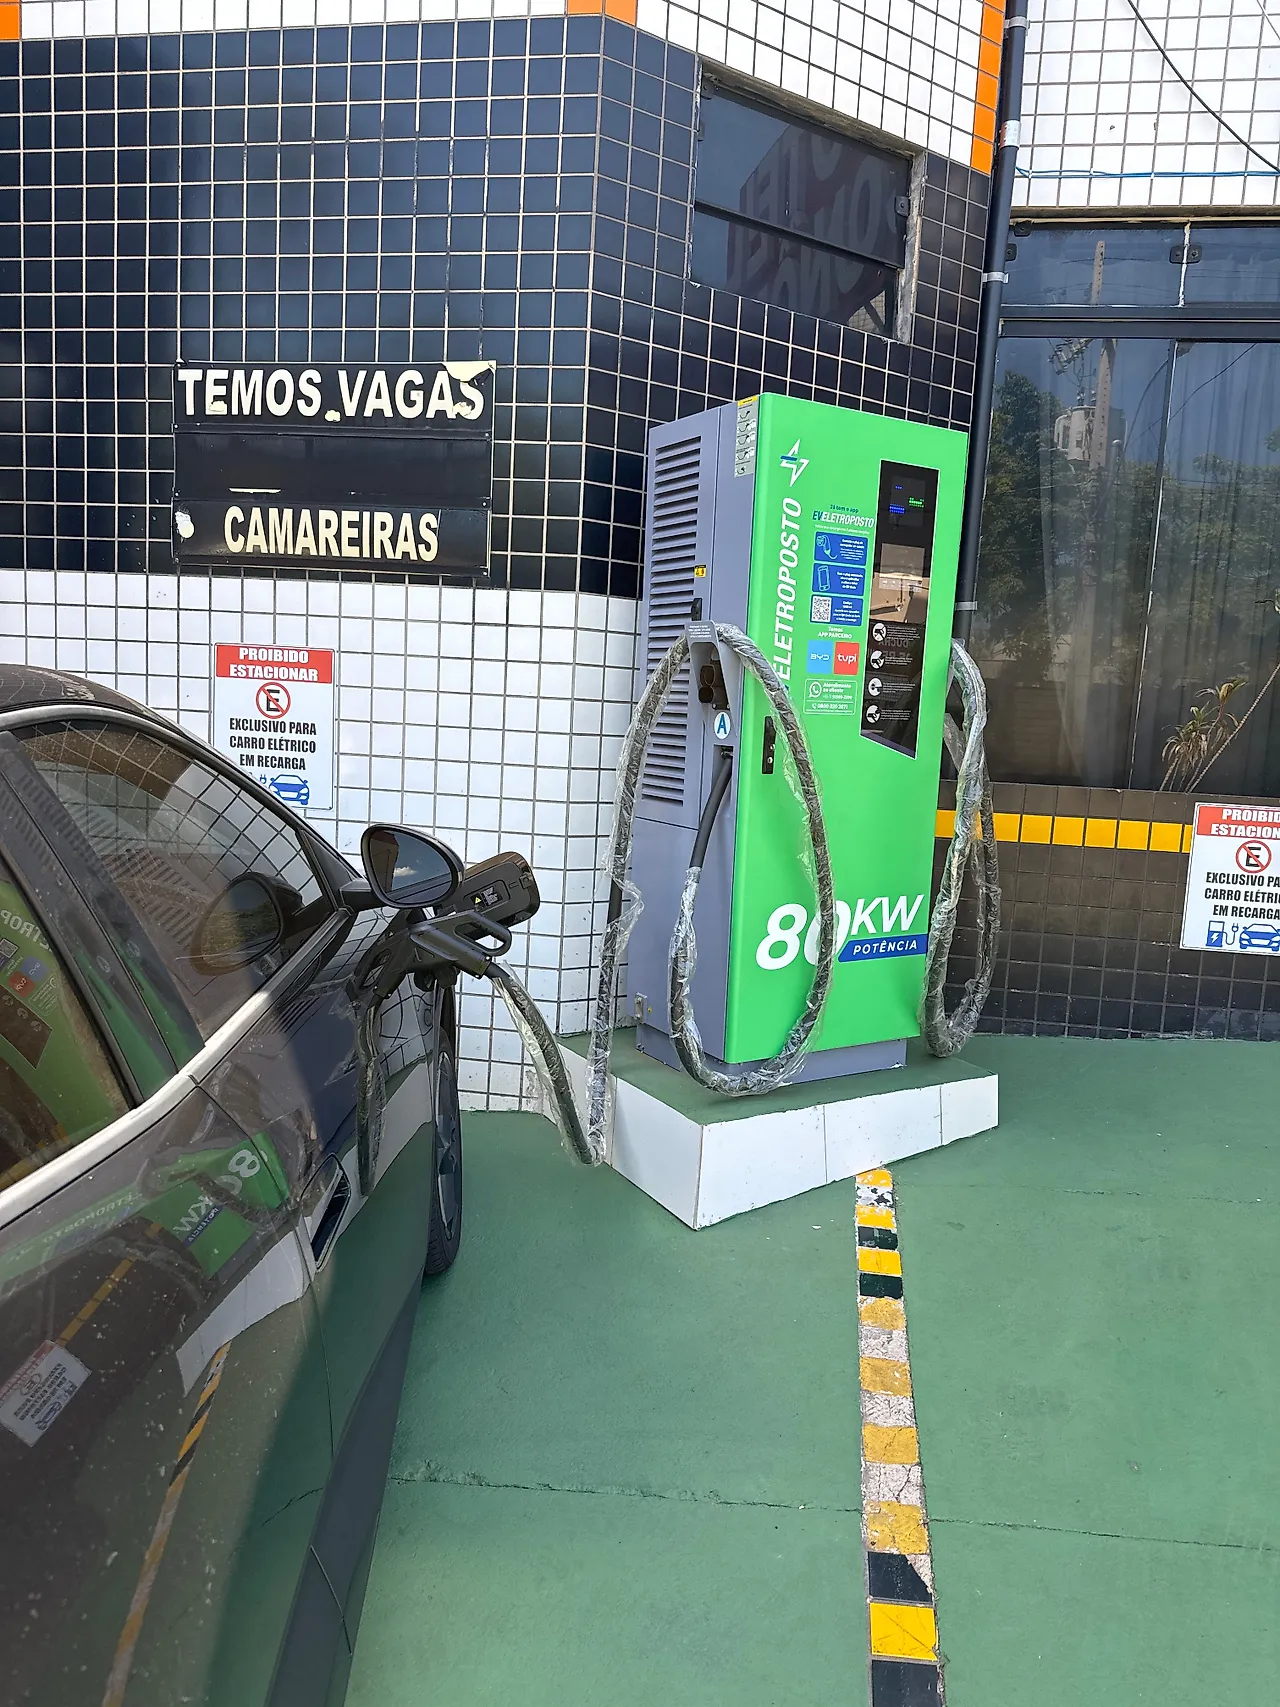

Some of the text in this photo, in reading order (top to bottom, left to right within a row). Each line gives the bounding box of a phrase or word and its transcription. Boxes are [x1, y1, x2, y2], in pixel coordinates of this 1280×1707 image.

[177, 368, 485, 420] TEMOS VAGAS
[224, 505, 440, 562] CAMAREIRAS
[239, 647, 309, 663] PROIBIDO
[837, 653, 857, 664] tupi
[229, 664, 319, 681] ESTACIONAR
[229, 718, 317, 735] EXCLUSIVO PARA
[716, 713, 727, 735] A
[229, 735, 316, 753] CARRO ELÉTRICO
[240, 753, 306, 770] EM RECARGA
[1206, 871, 1265, 887] EXCLUSIVO
[1204, 888, 1280, 904] CARRO ELÉTRI
[1212, 904, 1280, 920] EM RECARGA
[853, 939, 918, 956] POTÊNCIA
